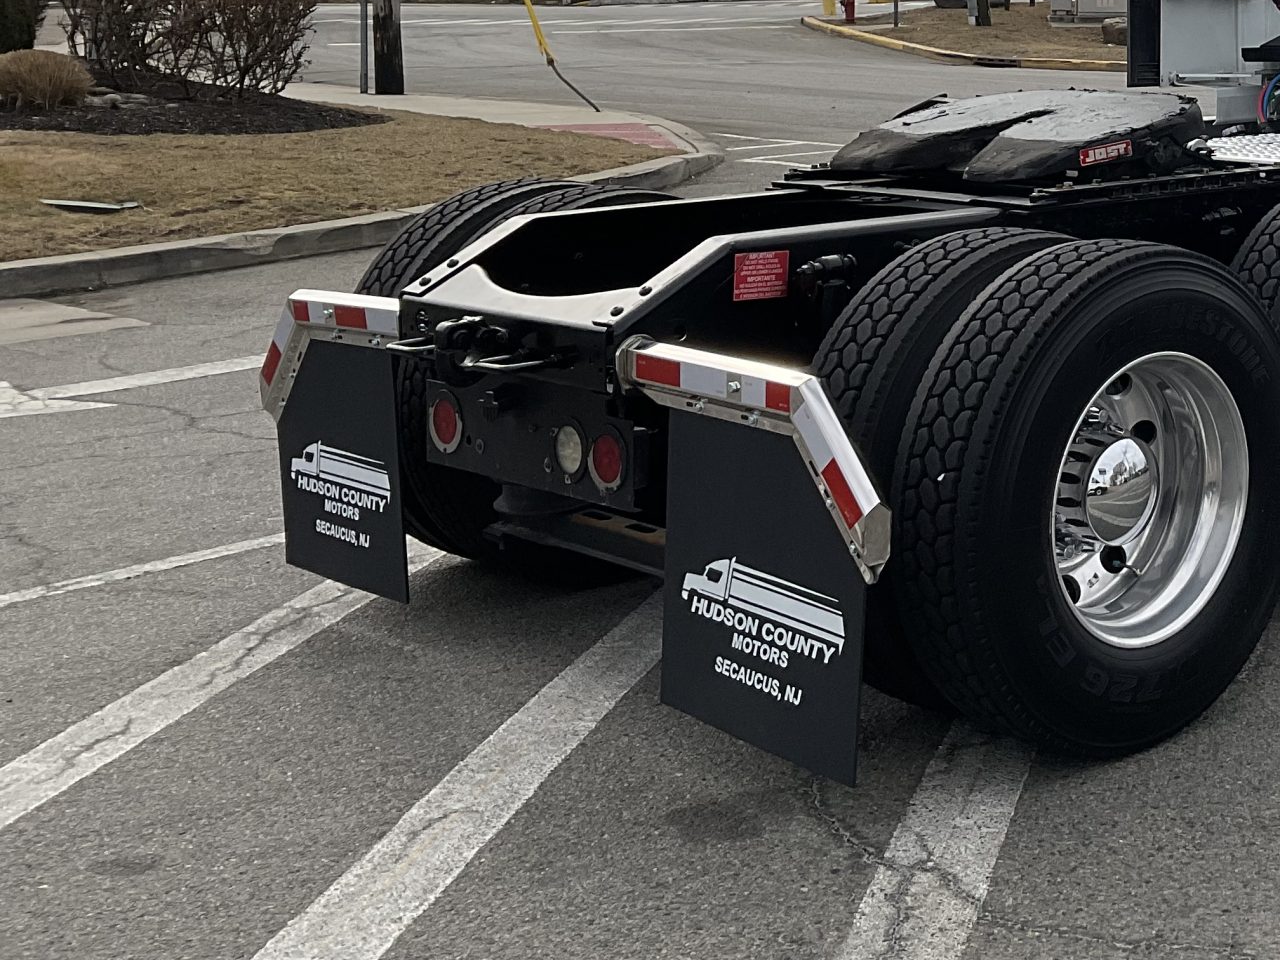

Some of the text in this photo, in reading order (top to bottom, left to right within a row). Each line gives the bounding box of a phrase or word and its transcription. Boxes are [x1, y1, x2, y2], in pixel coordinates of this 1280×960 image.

[1086, 144, 1126, 162] JOST
[297, 475, 386, 513] HUDSON COUNTY
[324, 499, 360, 521] MOTORS
[315, 519, 370, 548] SECAUCUS, NJ
[691, 595, 836, 664] HUDSON COUNTY
[731, 632, 789, 668] MOTORS
[714, 655, 803, 706] SECAUCUS, NJ
